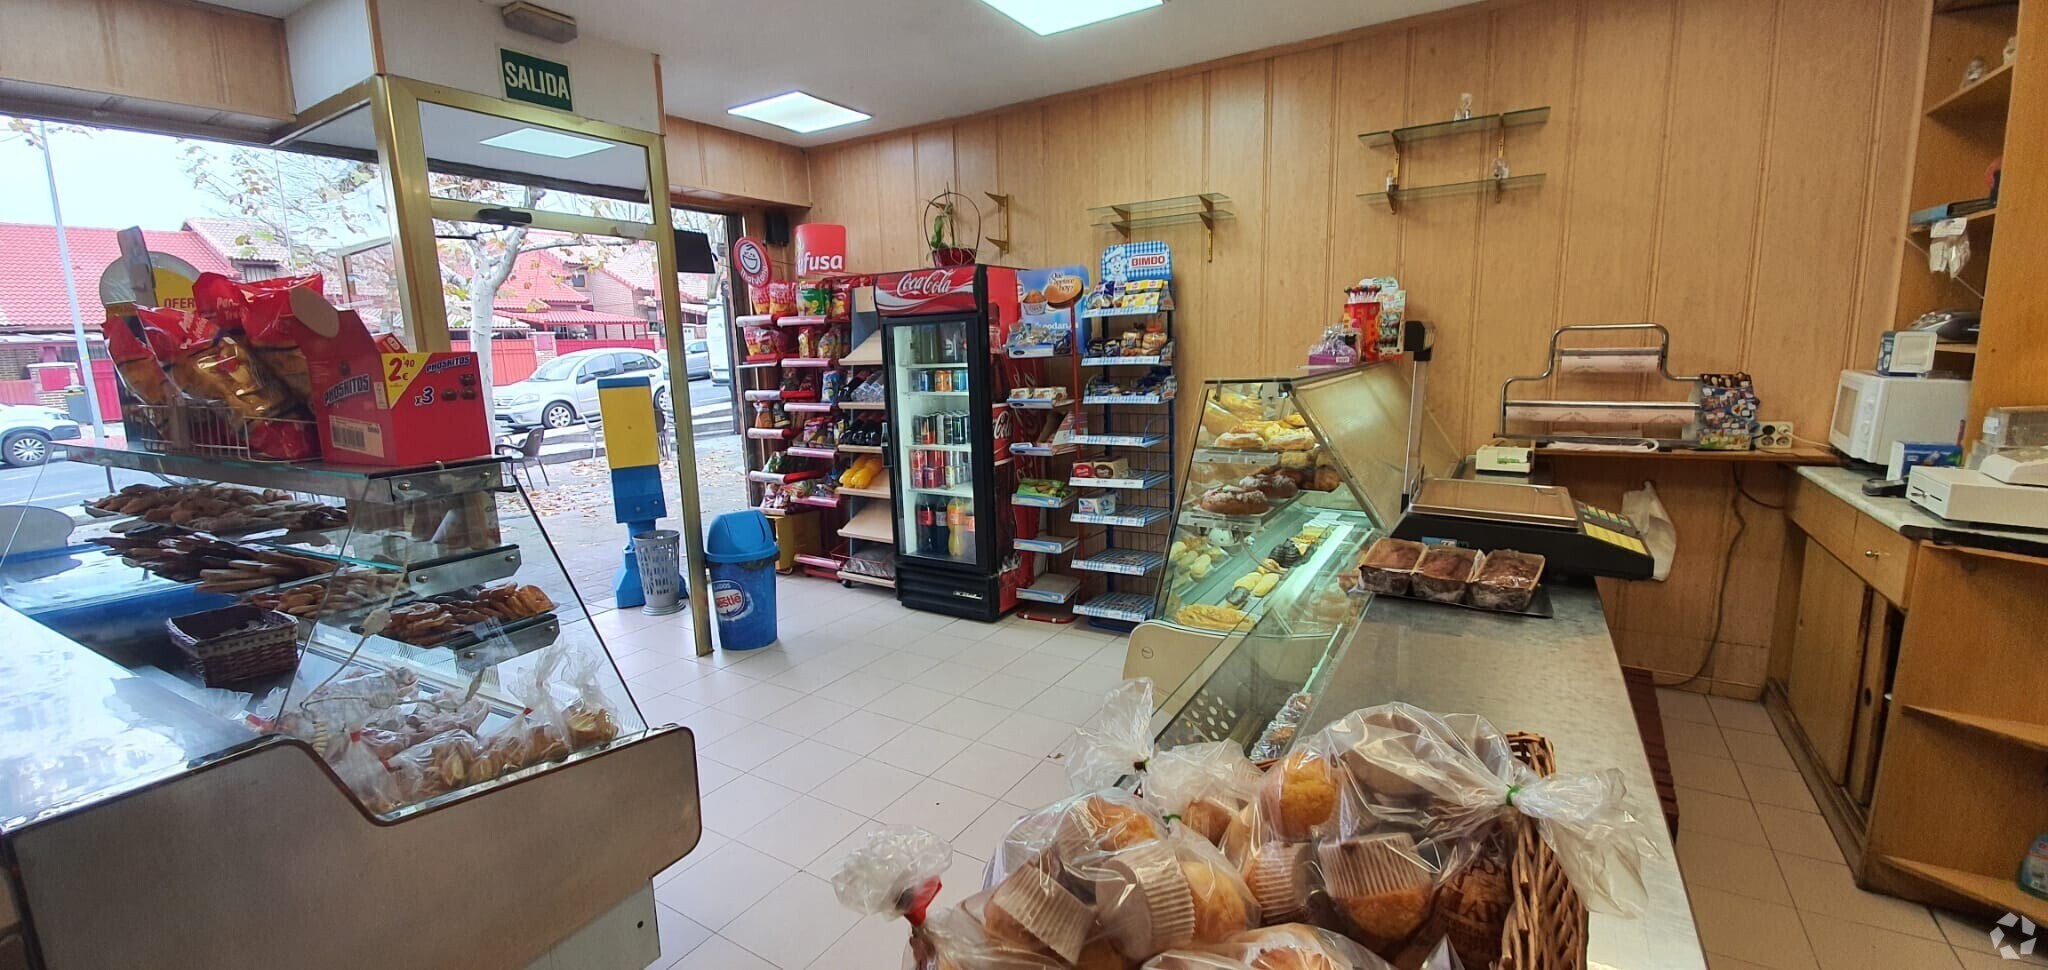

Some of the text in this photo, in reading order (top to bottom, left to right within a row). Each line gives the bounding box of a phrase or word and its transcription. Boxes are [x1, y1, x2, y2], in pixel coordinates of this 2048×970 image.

[504, 61, 570, 100] SALIDA
[797, 251, 843, 276] fusa
[1131, 256, 1166, 267] BIMBO
[896, 269, 957, 297] Coca-Cola
[426, 355, 471, 373] PHOSKITOS
[324, 374, 371, 407] PHOSKITOS
[415, 386, 434, 406] x3
